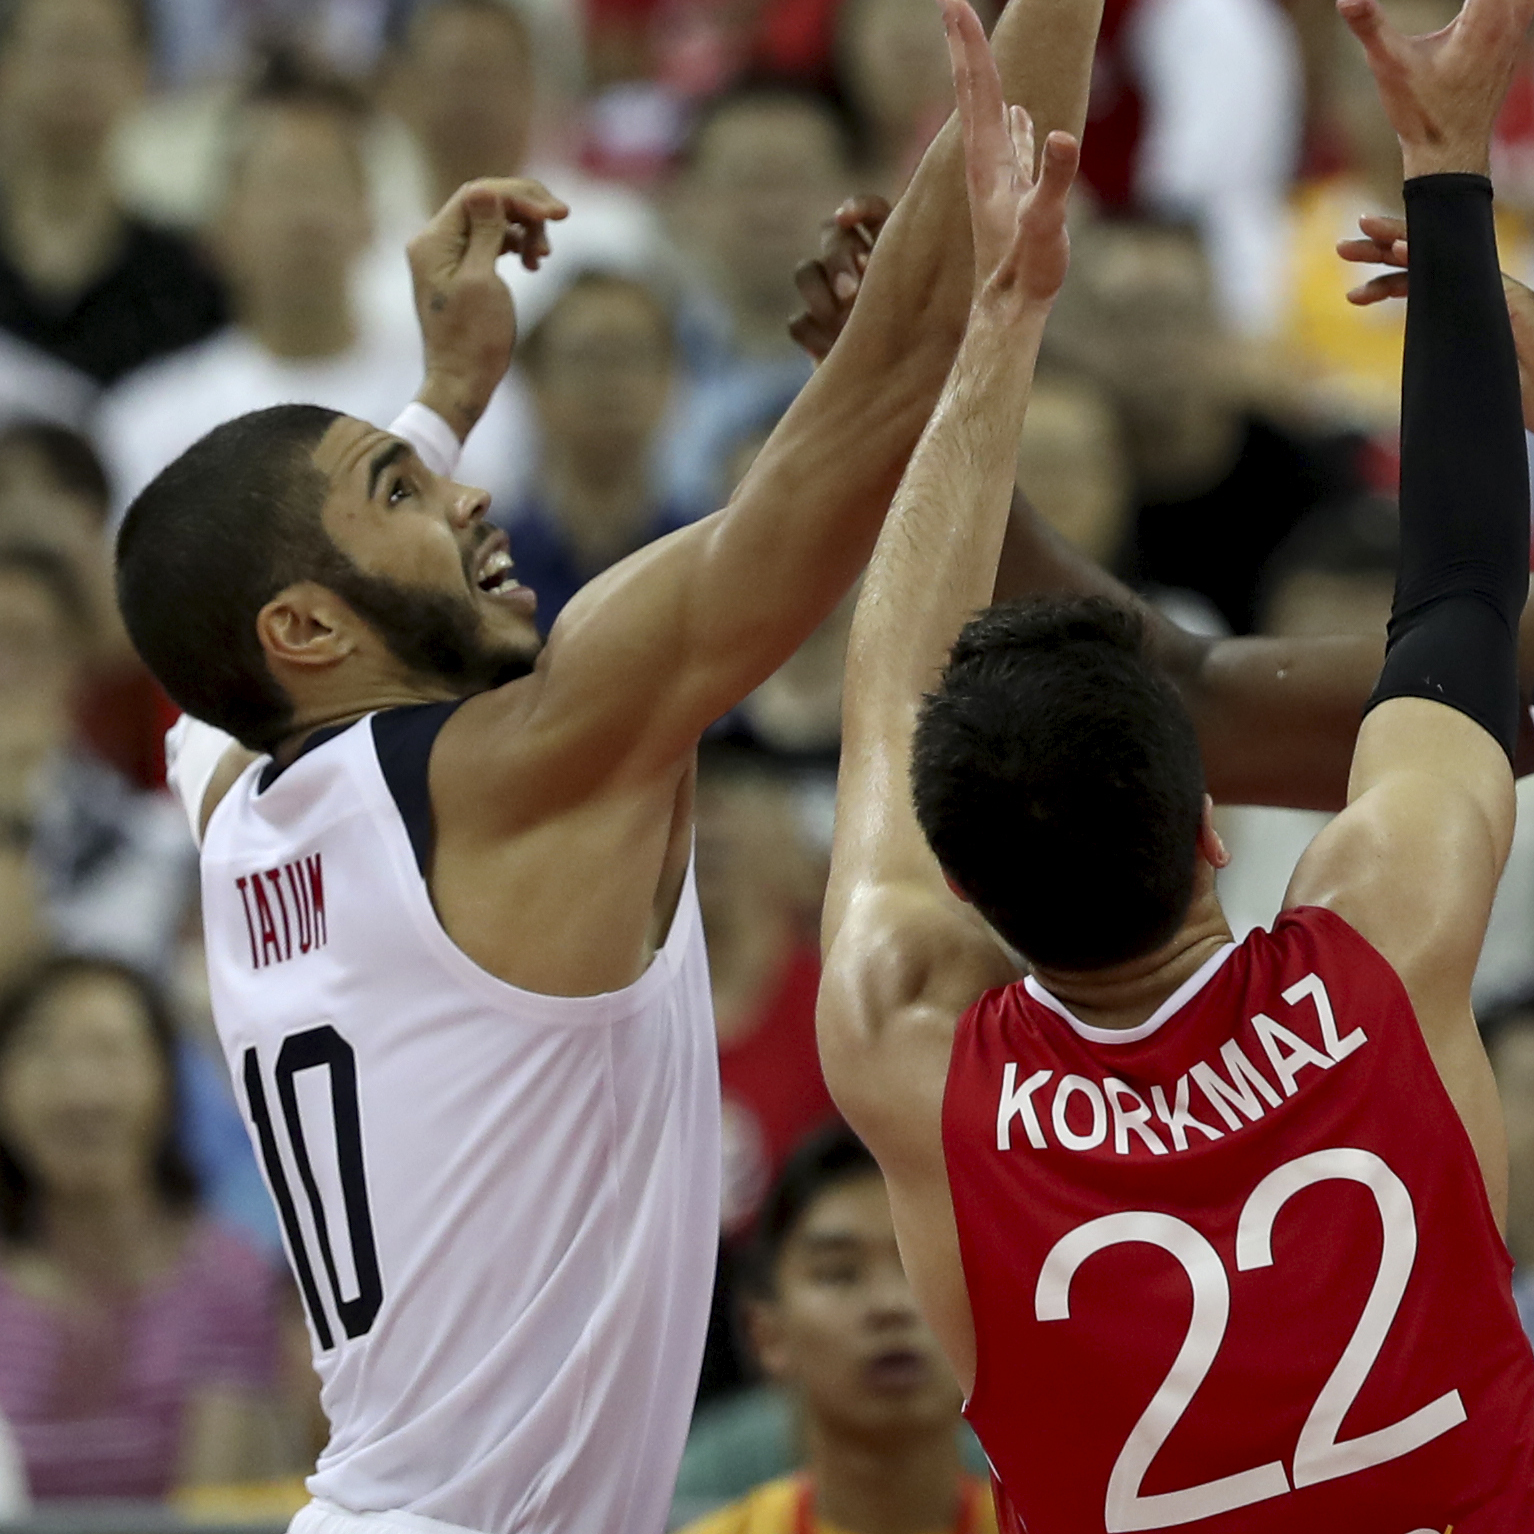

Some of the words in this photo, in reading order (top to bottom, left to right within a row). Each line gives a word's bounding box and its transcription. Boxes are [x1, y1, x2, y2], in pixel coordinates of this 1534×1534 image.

[235, 852, 328, 969] TATUM
[243, 1024, 384, 1351] 10
[996, 972, 1369, 1155] KORKMAZ
[1034, 1147, 1468, 1533] 22
